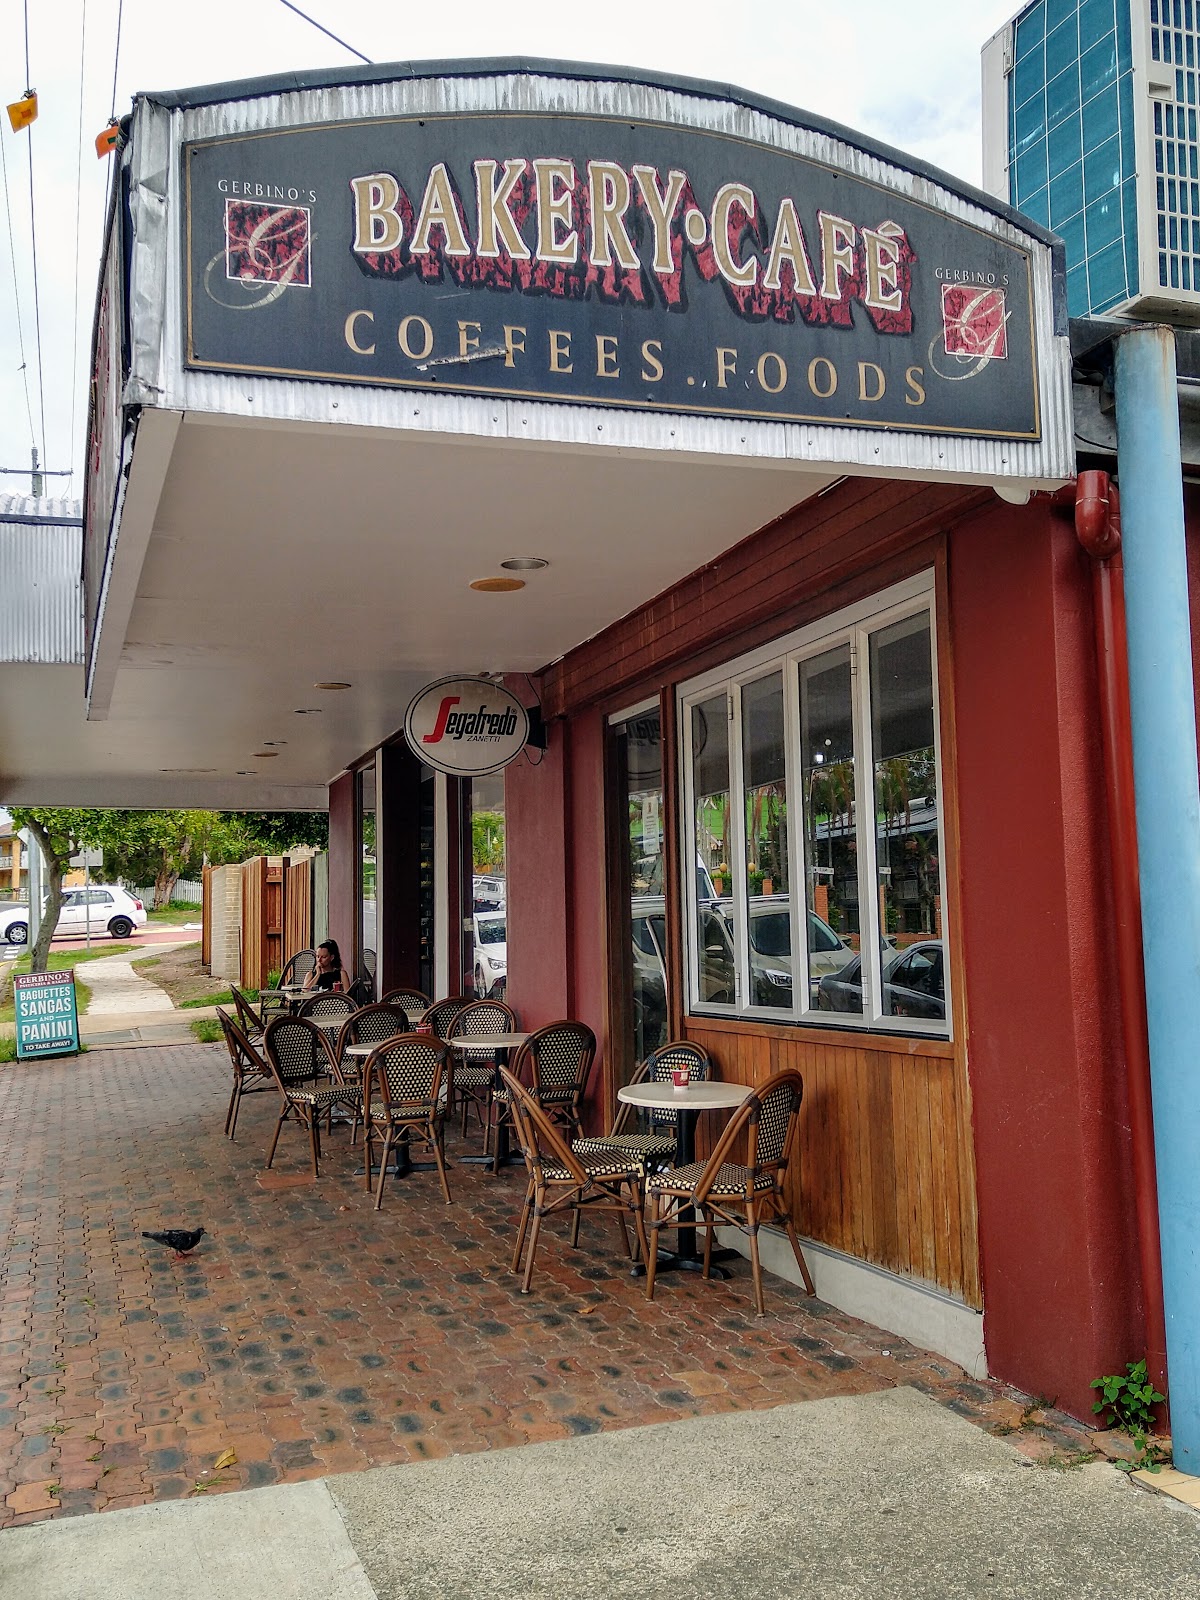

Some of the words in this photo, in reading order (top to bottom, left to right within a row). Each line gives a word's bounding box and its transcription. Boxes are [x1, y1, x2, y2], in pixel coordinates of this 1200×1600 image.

[217, 179, 317, 203] GERBINO'S
[351, 158, 687, 274] BAKERY
[934, 267, 1009, 285] GERBINOS
[344, 309, 664, 382] COFFEES
[715, 346, 926, 406] FOODS
[422, 696, 518, 744] Segafredo
[20, 972, 70, 984] GERBINO'S
[20, 987, 70, 1001] BAGUETTES
[21, 998, 71, 1016] SANGAS
[22, 1020, 72, 1041] PANINI
